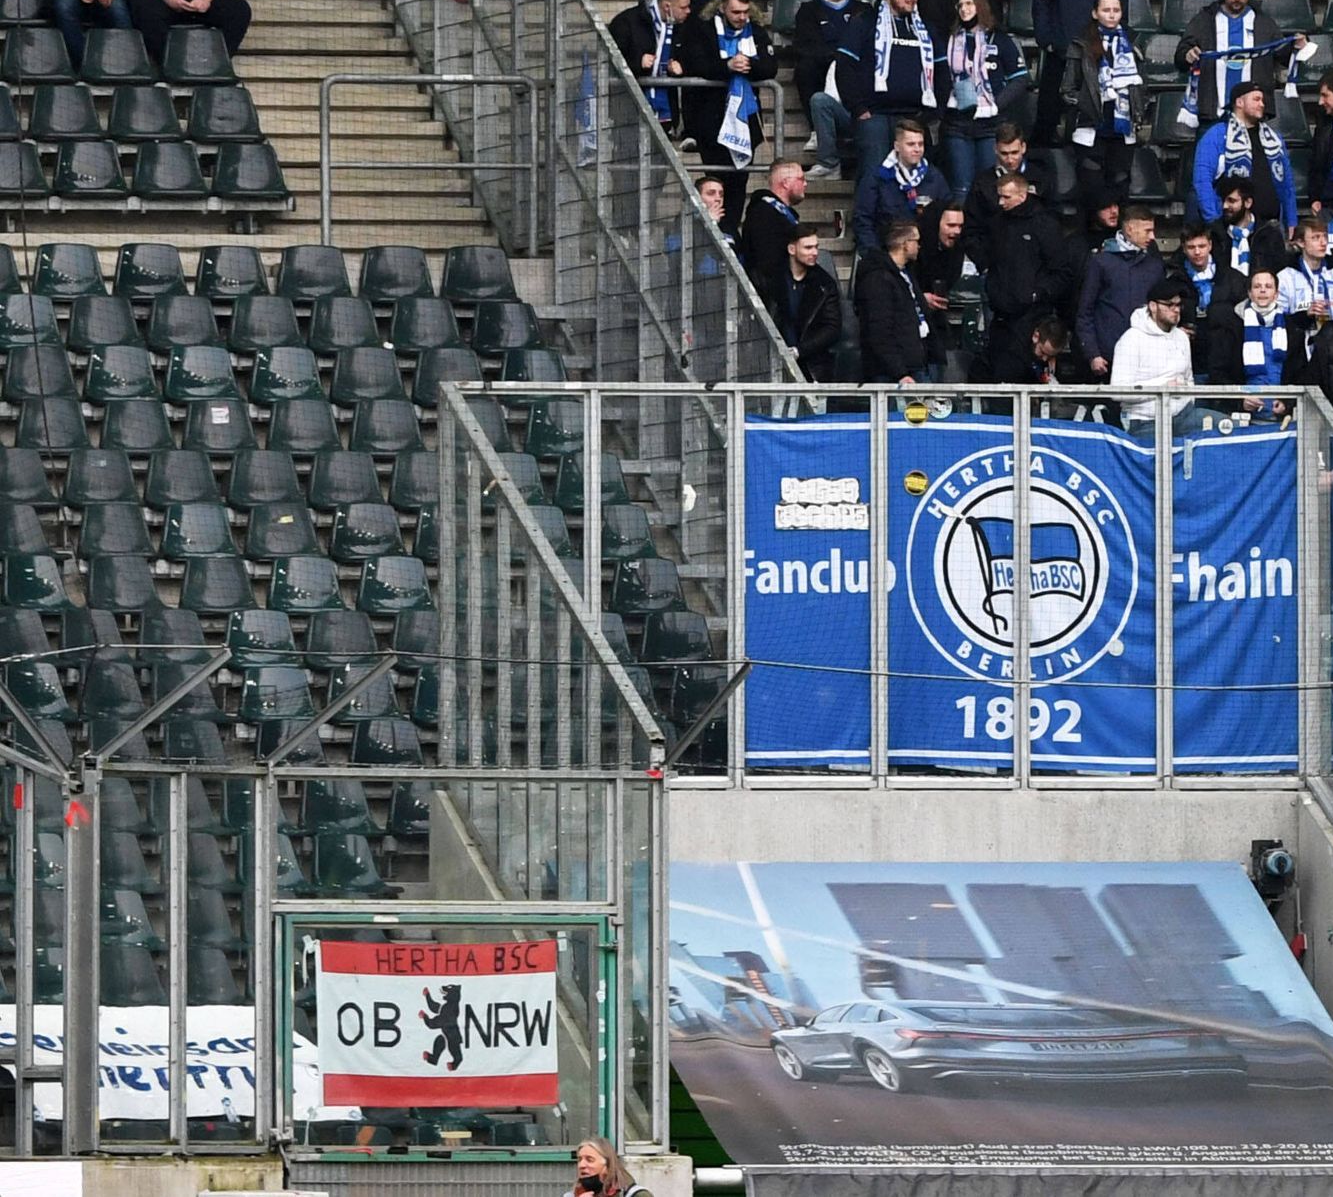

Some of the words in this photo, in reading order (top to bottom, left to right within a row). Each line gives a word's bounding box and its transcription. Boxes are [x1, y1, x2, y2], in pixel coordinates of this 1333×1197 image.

[1066, 472, 1115, 526] BSC
[955, 695, 1083, 744] 1892
[374, 948, 478, 974] HERTHA
[493, 943, 541, 971] BSC
[337, 1001, 402, 1048] OB
[464, 999, 552, 1049] NRW
